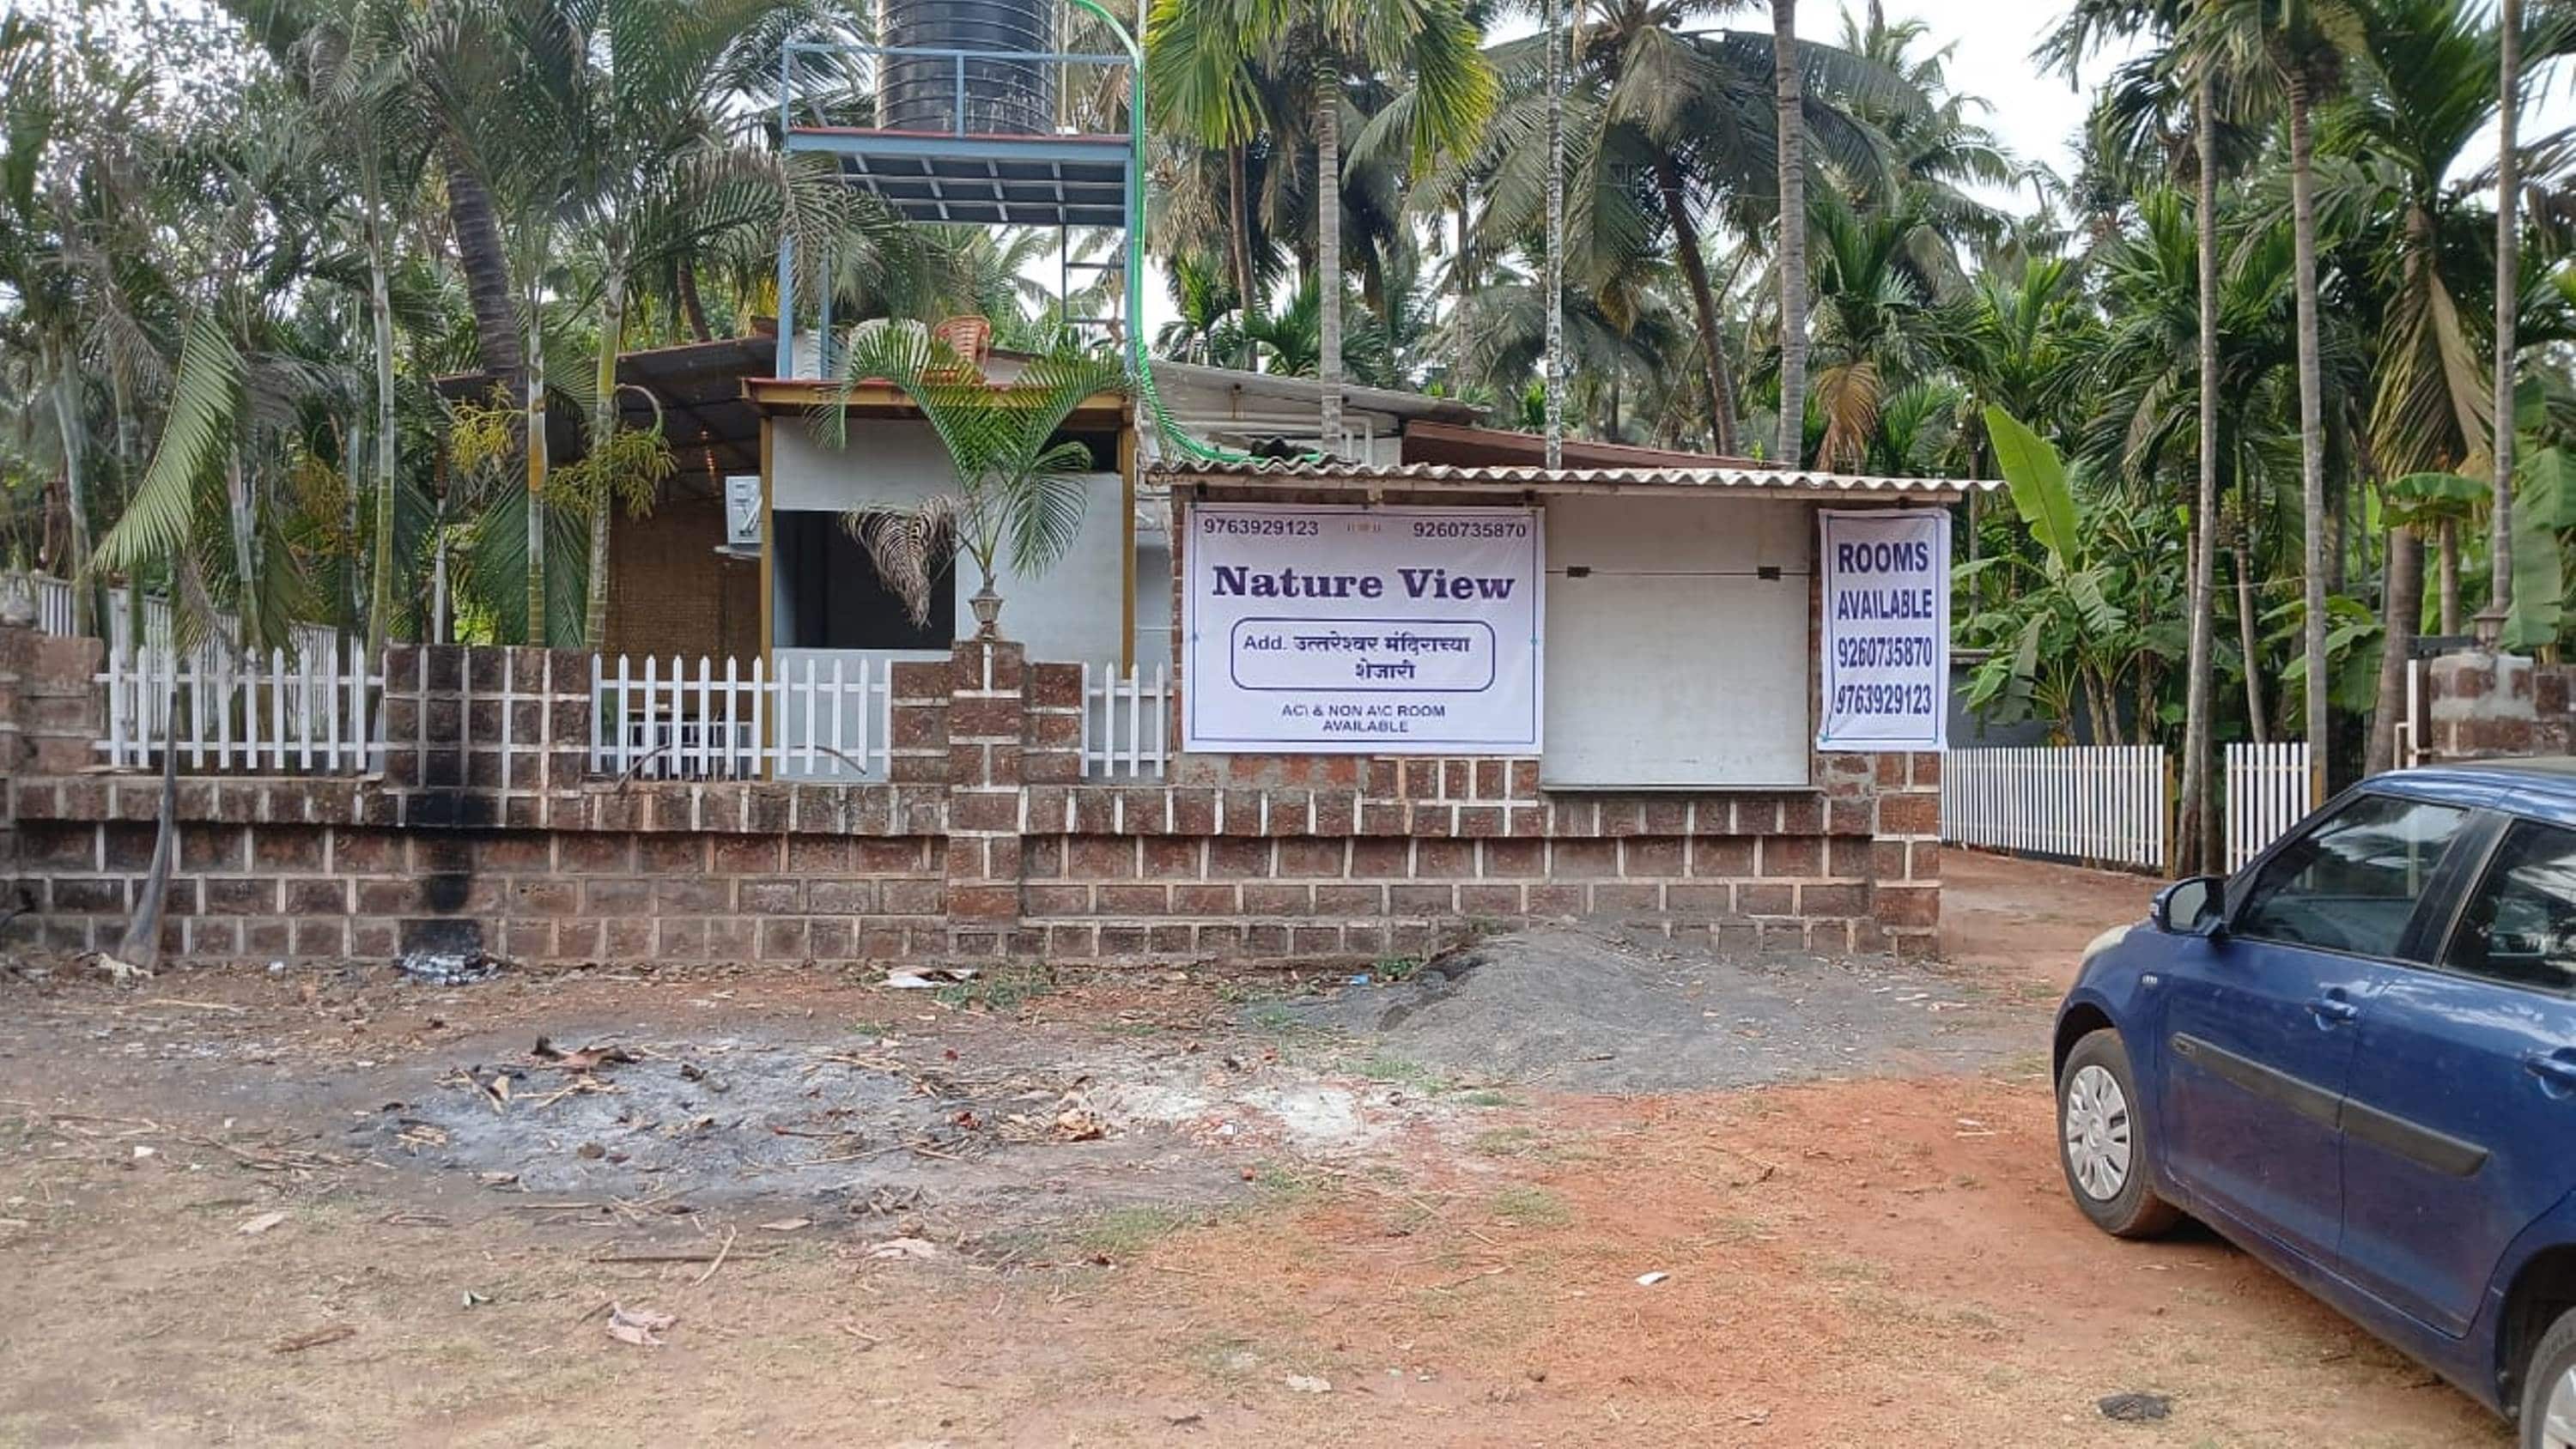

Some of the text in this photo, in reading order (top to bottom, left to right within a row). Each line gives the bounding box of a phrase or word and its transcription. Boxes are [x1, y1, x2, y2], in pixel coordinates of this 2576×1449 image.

[1204, 518, 1319, 537] 9763929123
[1413, 522, 1527, 538] 9260735870
[1838, 542, 1929, 573] ROOMS
[1212, 566, 1516, 600] Nature View
[1838, 588, 1932, 621] AVAILABLE
[1243, 635, 1288, 651] Add.
[1384, 631, 1471, 656] मंदिराच्या
[1838, 636, 1932, 668] 9260735870
[1356, 658, 1417, 680] शेजारी
[1313, 706, 1323, 717] &
[1329, 705, 1363, 717] NON
[1397, 706, 1446, 718] ROOM
[1836, 683, 1931, 715] 9763929123
[1322, 720, 1409, 732] AVAILABLE
